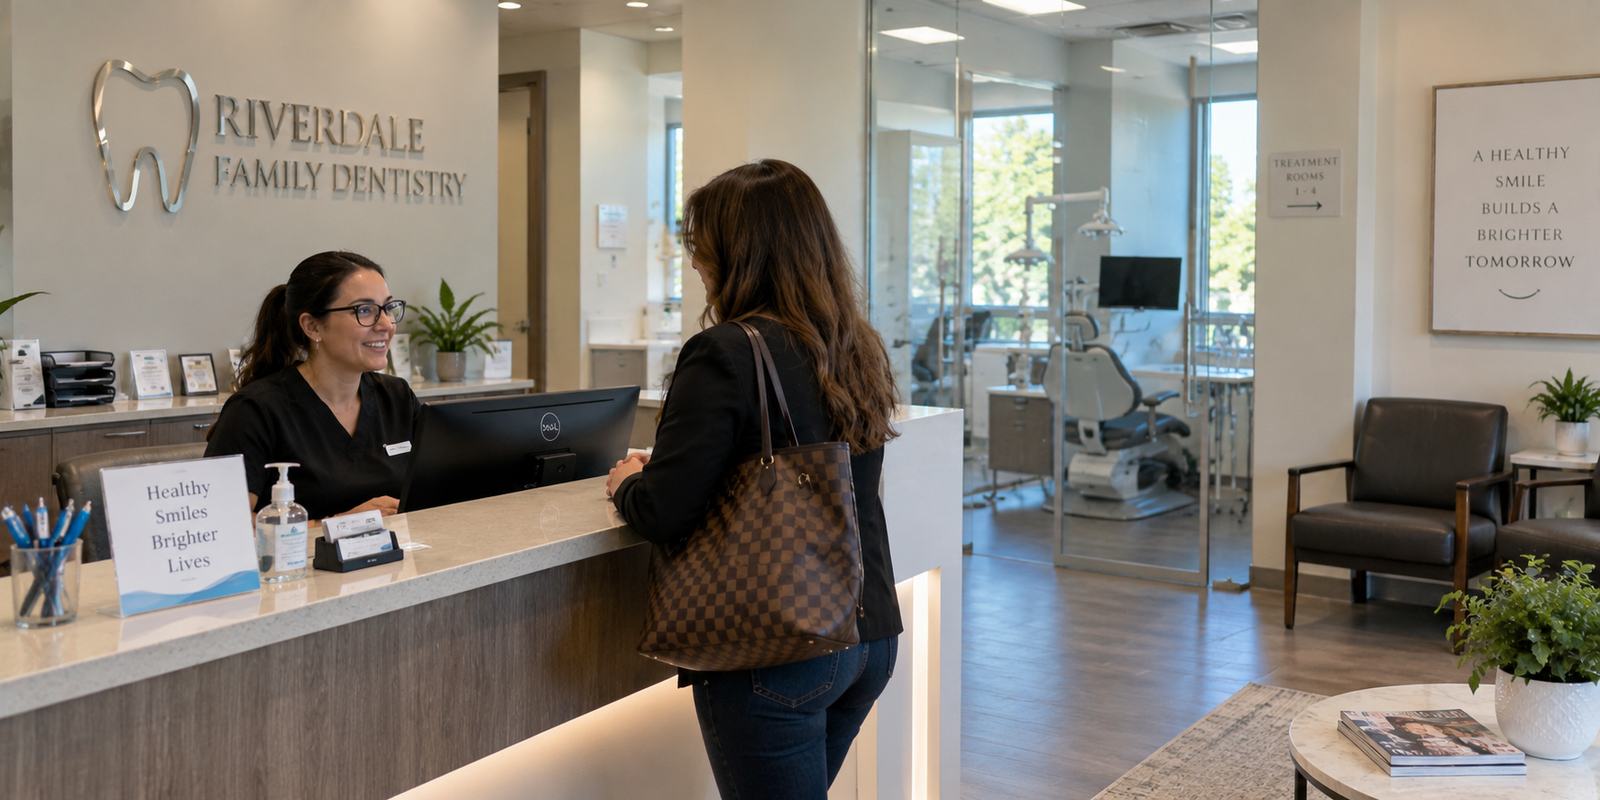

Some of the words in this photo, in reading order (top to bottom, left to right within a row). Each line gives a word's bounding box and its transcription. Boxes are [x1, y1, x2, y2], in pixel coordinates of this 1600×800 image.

[214, 94, 425, 154] RIVERDALE
[1473, 149, 1484, 162] A
[1490, 146, 1570, 162] HEALTHY
[1274, 157, 1338, 168] TREATMENT
[214, 155, 324, 192] FAMILY
[332, 163, 467, 199] DENTISTRY
[1286, 171, 1325, 182] ROOMS
[1495, 174, 1546, 188] SMILE
[1481, 202, 1541, 215] BUILDS
[1547, 201, 1559, 214] A
[1477, 228, 1563, 241] BRIGHTER
[1465, 255, 1575, 269] TOMORROW
[147, 480, 210, 501] Healthy
[155, 505, 208, 525] Smiles
[152, 530, 218, 551] Brighter
[168, 556, 211, 574] Lives
